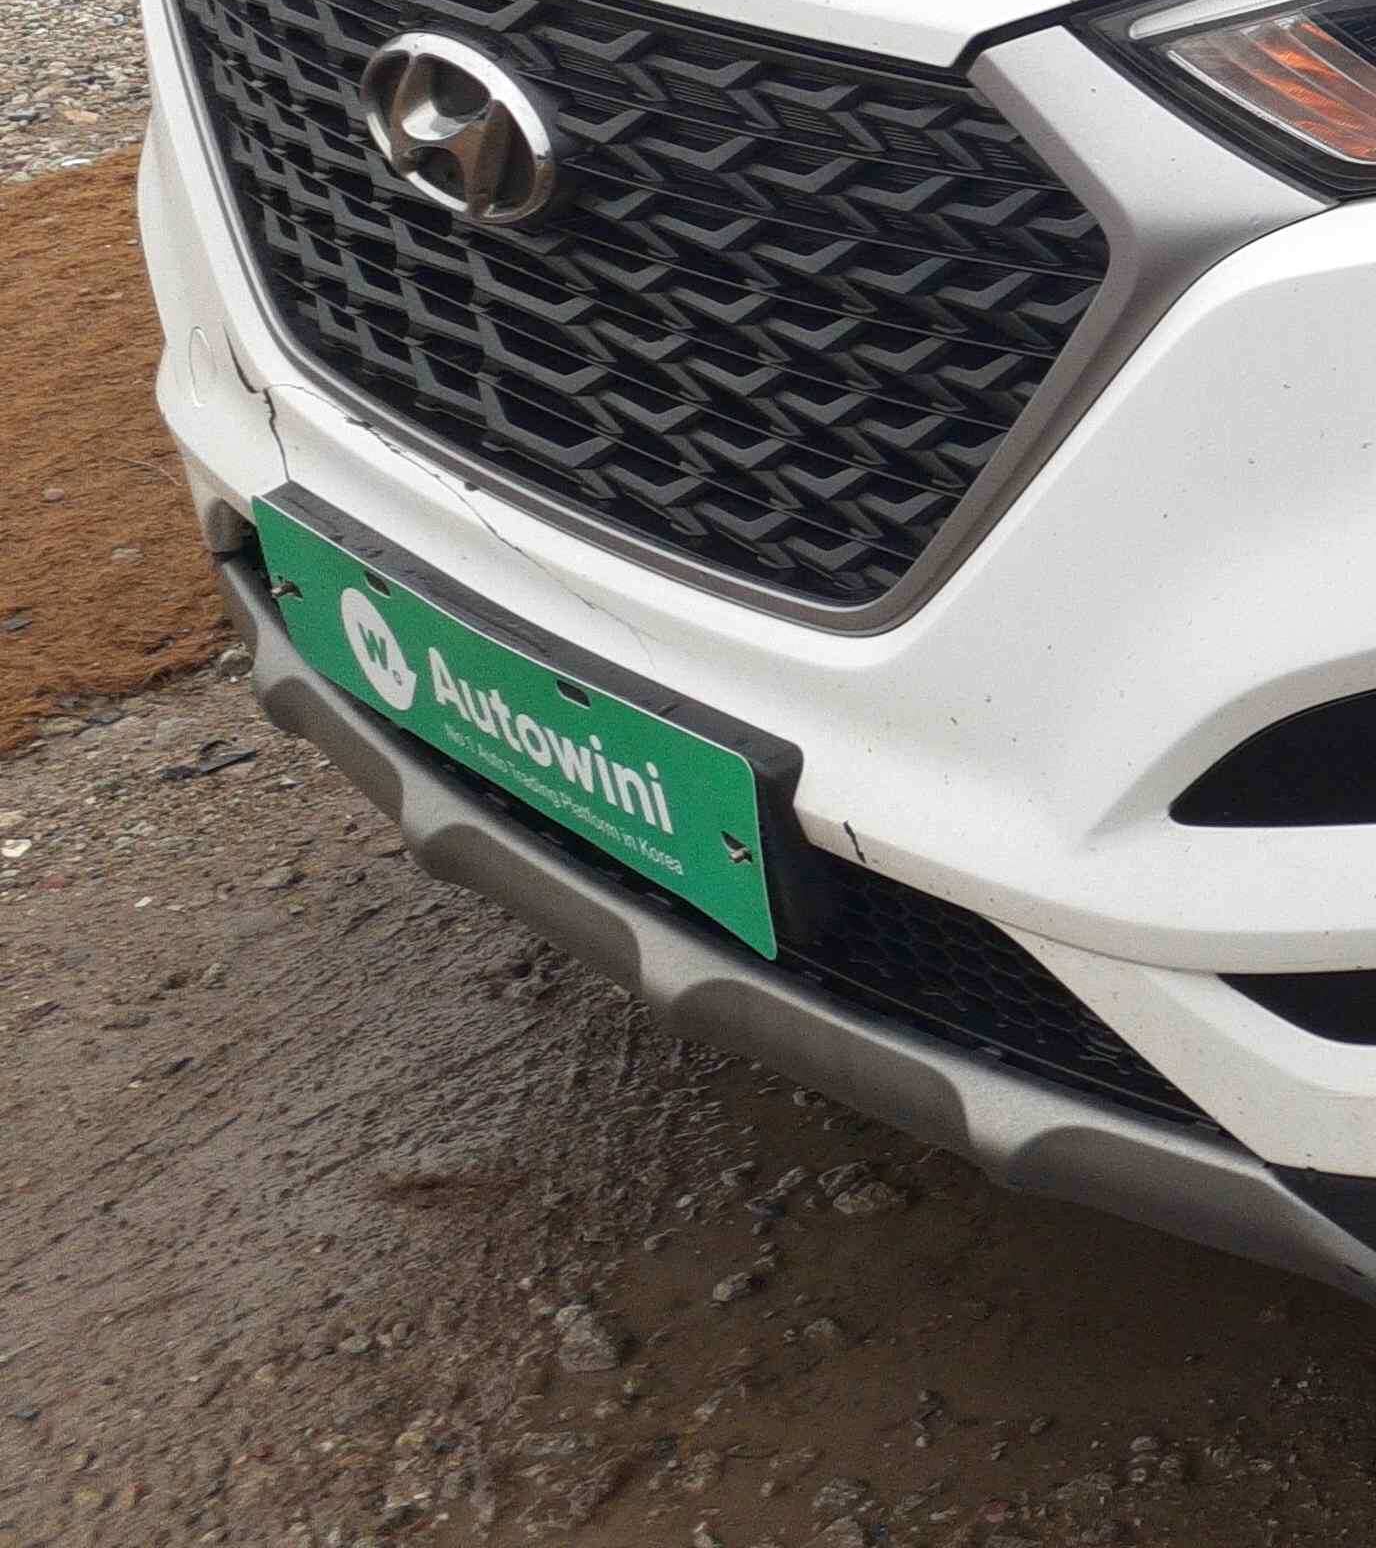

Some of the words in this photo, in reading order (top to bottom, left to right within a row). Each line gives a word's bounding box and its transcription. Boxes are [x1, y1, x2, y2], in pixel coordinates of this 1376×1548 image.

[428, 647, 674, 835] Autowini
[560, 791, 621, 842] Platform
[637, 836, 685, 876] Korea
